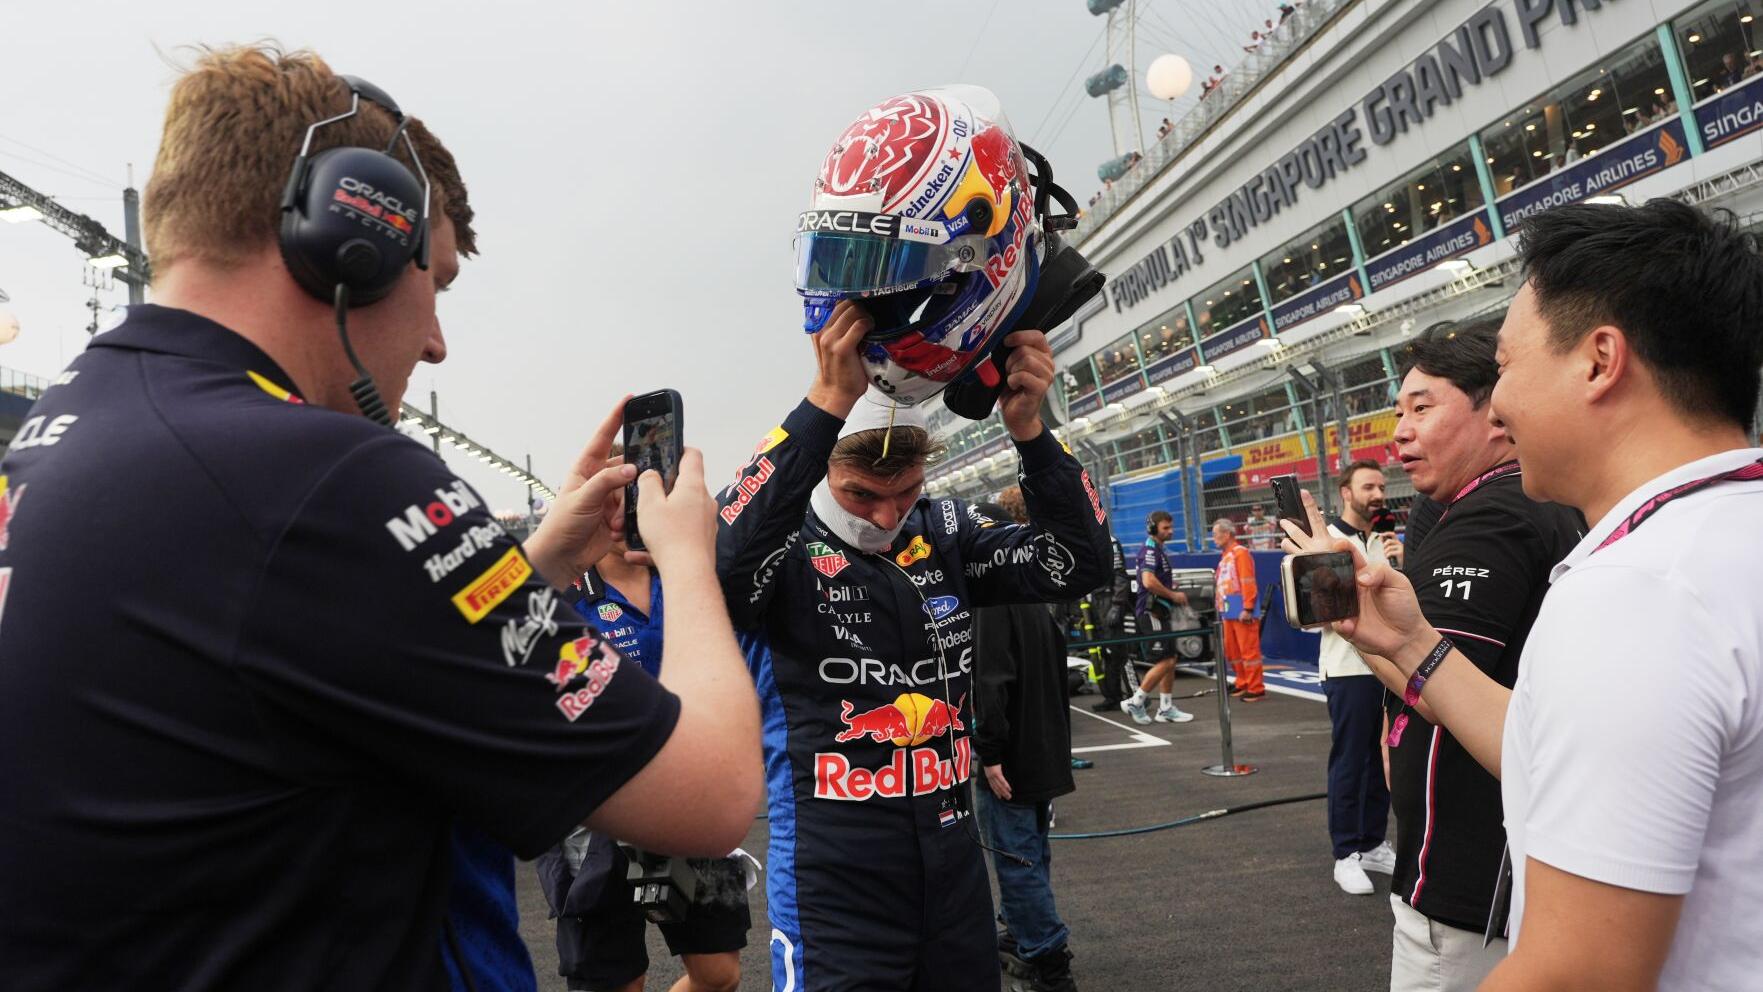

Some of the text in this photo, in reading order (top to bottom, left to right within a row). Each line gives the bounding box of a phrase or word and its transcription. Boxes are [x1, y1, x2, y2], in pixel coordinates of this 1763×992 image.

[1703, 100, 1763, 142] SINGA
[1109, 233, 1192, 313] FORMULA
[1208, 107, 1367, 249] SINGAPORE
[1363, 6, 1514, 146] GRAND
[339, 177, 418, 223] ORACLE
[898, 163, 954, 219] eineken
[1502, 149, 1658, 229] SINGAPORE AIRLINES
[905, 224, 930, 236] Mobil
[948, 215, 969, 232] VISA
[983, 211, 1025, 291] Red
[1370, 230, 1475, 287] SINGAPORE AIRLINES
[9, 414, 80, 450] CLE
[1249, 443, 1285, 464] DHL
[720, 484, 753, 526] Red
[741, 455, 776, 496] Bull
[385, 479, 482, 552] Mobil
[423, 541, 477, 583] Hard
[810, 543, 835, 556] TA
[811, 556, 850, 575] HEUER
[465, 555, 527, 613] PIRELLI
[1432, 565, 1490, 578] PÉREZ
[1440, 579, 1472, 601] 11
[600, 603, 620, 613] TAG
[817, 603, 873, 624] CALYLE
[600, 627, 626, 640] Mobil
[615, 639, 638, 648] ACLE
[831, 625, 863, 646] VIA
[818, 646, 973, 688] ORACLE
[556, 672, 605, 722] Red
[814, 736, 972, 801] Red Bull
